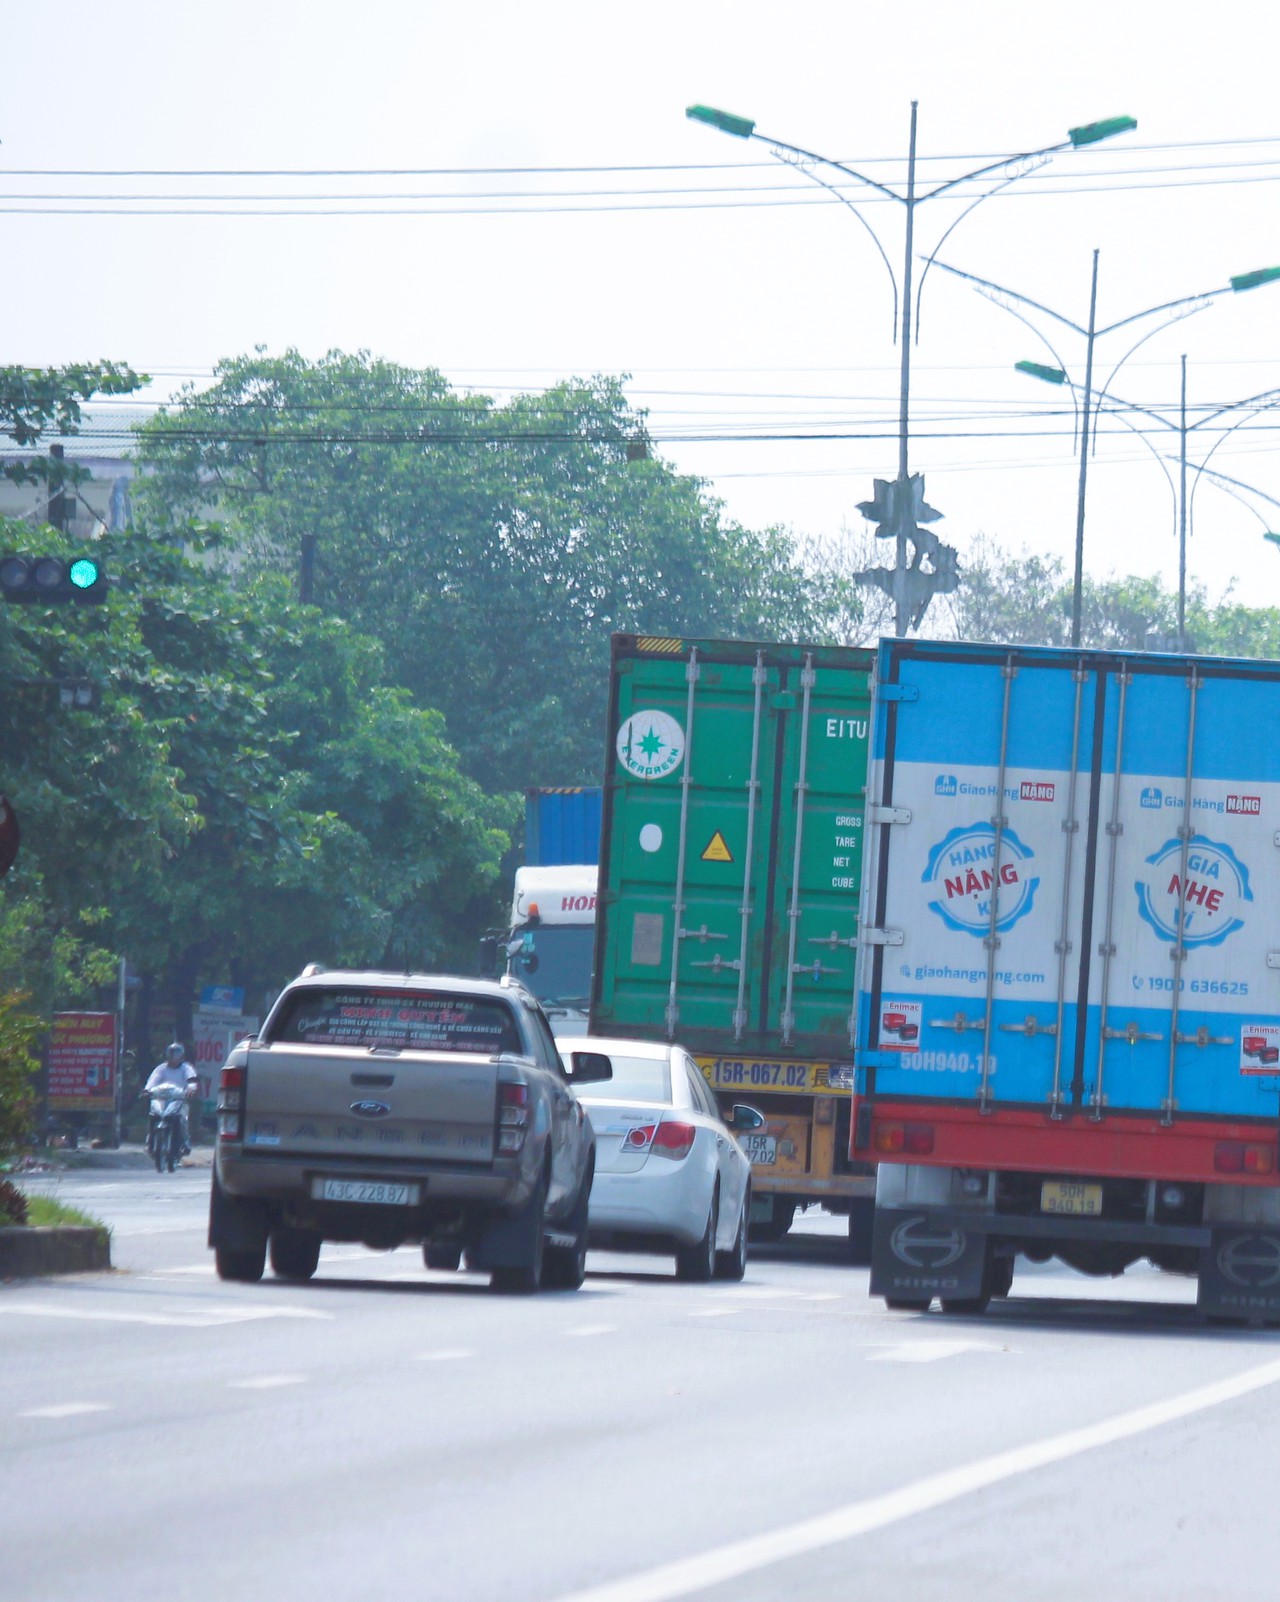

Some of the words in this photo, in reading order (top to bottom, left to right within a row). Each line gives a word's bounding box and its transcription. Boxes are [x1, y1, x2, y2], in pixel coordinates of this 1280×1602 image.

[826, 719, 866, 738] EITU
[987, 785, 1019, 801] Hng
[1165, 796, 1188, 808] Gia
[835, 816, 861, 827] GROSS
[835, 836, 855, 847] TARE
[833, 857, 850, 867] NET
[1187, 854, 1220, 880] GIÁ
[832, 877, 854, 888] CUBE
[1167, 874, 1224, 917] NHẸ
[915, 965, 1045, 985] giaohangnng.com
[1190, 980, 1249, 996] 636625
[714, 1062, 806, 1087] 15R-067.02
